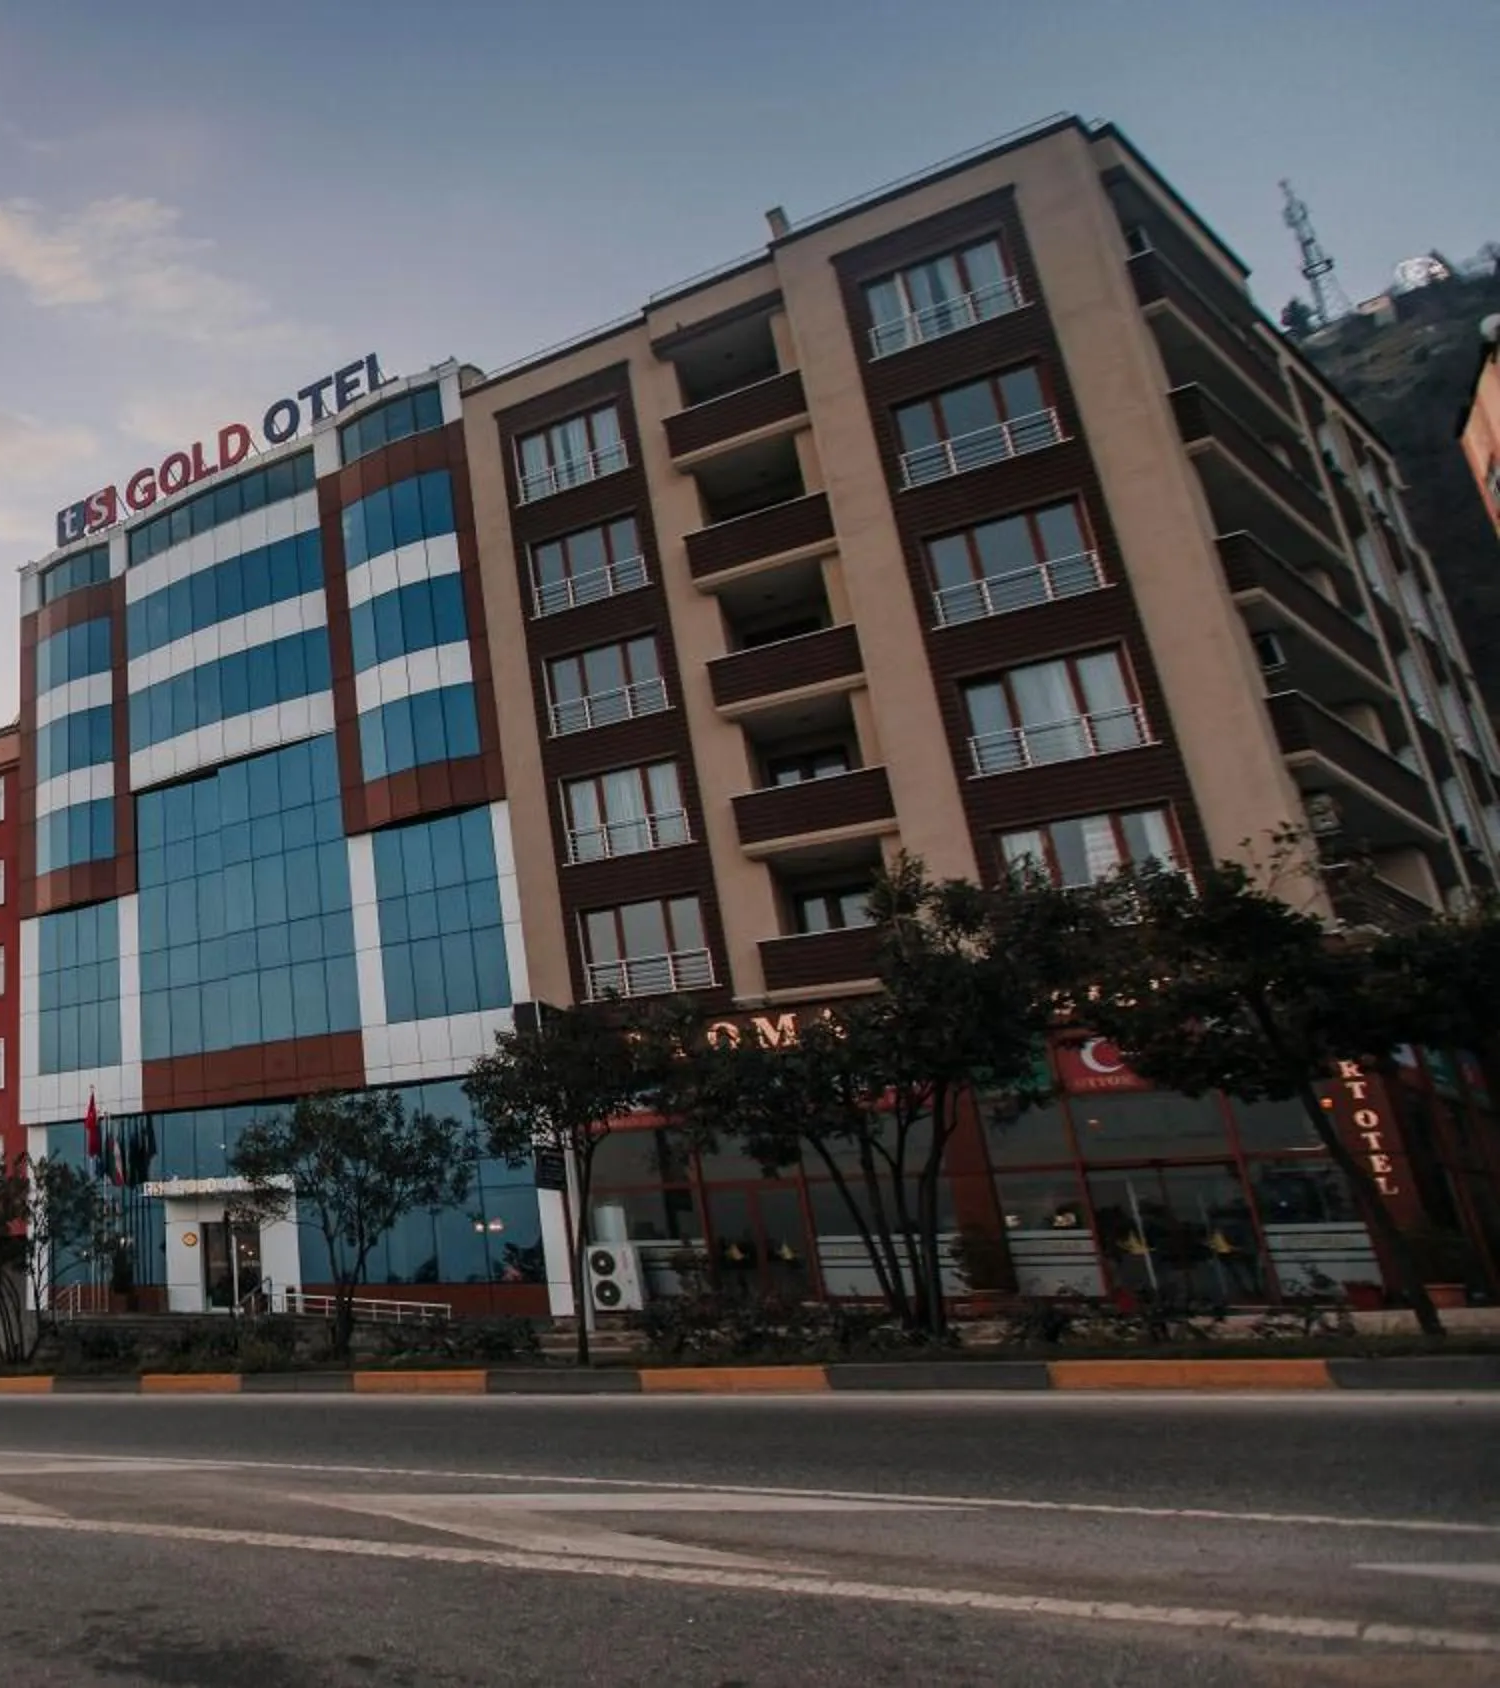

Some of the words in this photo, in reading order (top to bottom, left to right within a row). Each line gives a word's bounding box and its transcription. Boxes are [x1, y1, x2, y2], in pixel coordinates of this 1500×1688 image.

[125, 423, 251, 511] GOLD
[263, 352, 398, 445] OTEL
[1352, 1108, 1400, 1196] OTEL
